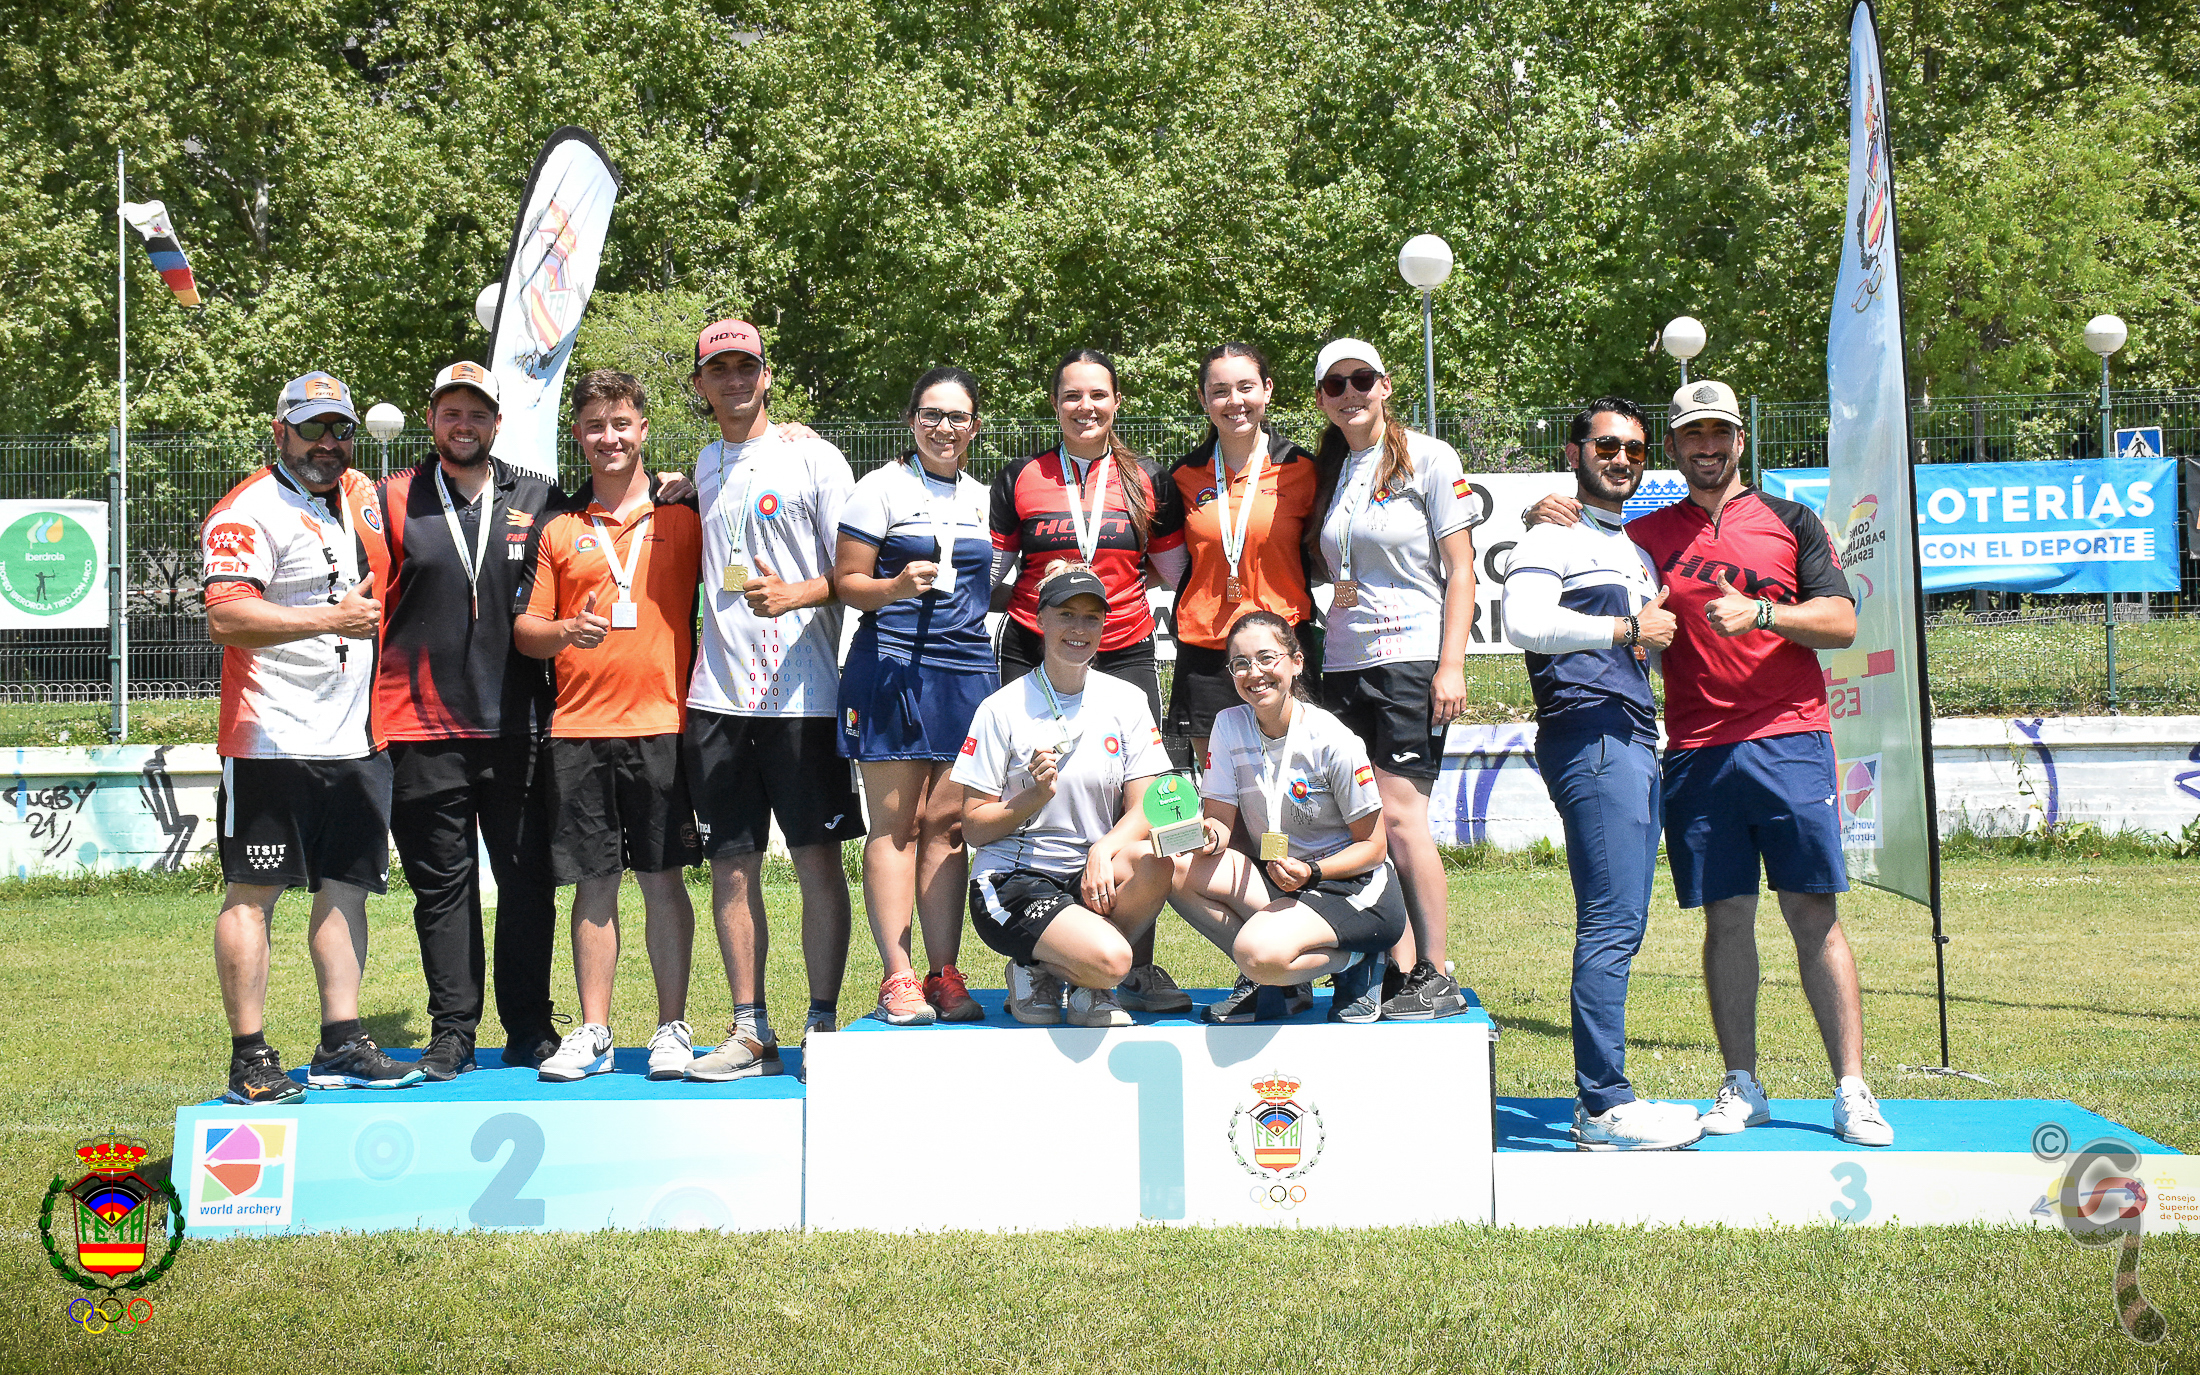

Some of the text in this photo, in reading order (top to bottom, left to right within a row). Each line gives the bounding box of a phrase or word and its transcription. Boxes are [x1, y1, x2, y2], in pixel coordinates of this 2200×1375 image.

[708, 331, 749, 344] HOYT
[1924, 536, 2136, 560] CON EL DEPORTE
[25, 552, 66, 561] Iberdrola
[10, 590, 53, 610] IBERDROLA
[53, 596, 72, 608] TIRO
[71, 582, 86, 598] CON
[82, 560, 93, 584] ARCO
[246, 844, 286, 856] ETSIT
[1107, 1040, 1186, 1220] 1
[1255, 1121, 1299, 1147] FETA
[469, 1112, 546, 1226] 2
[1830, 1161, 1872, 1224] 3
[2158, 1193, 2196, 1203] Consejo
[200, 1203, 282, 1218] world archery
[2159, 1203, 2199, 1212] Superior
[2174, 1212, 2200, 1222] Depo
